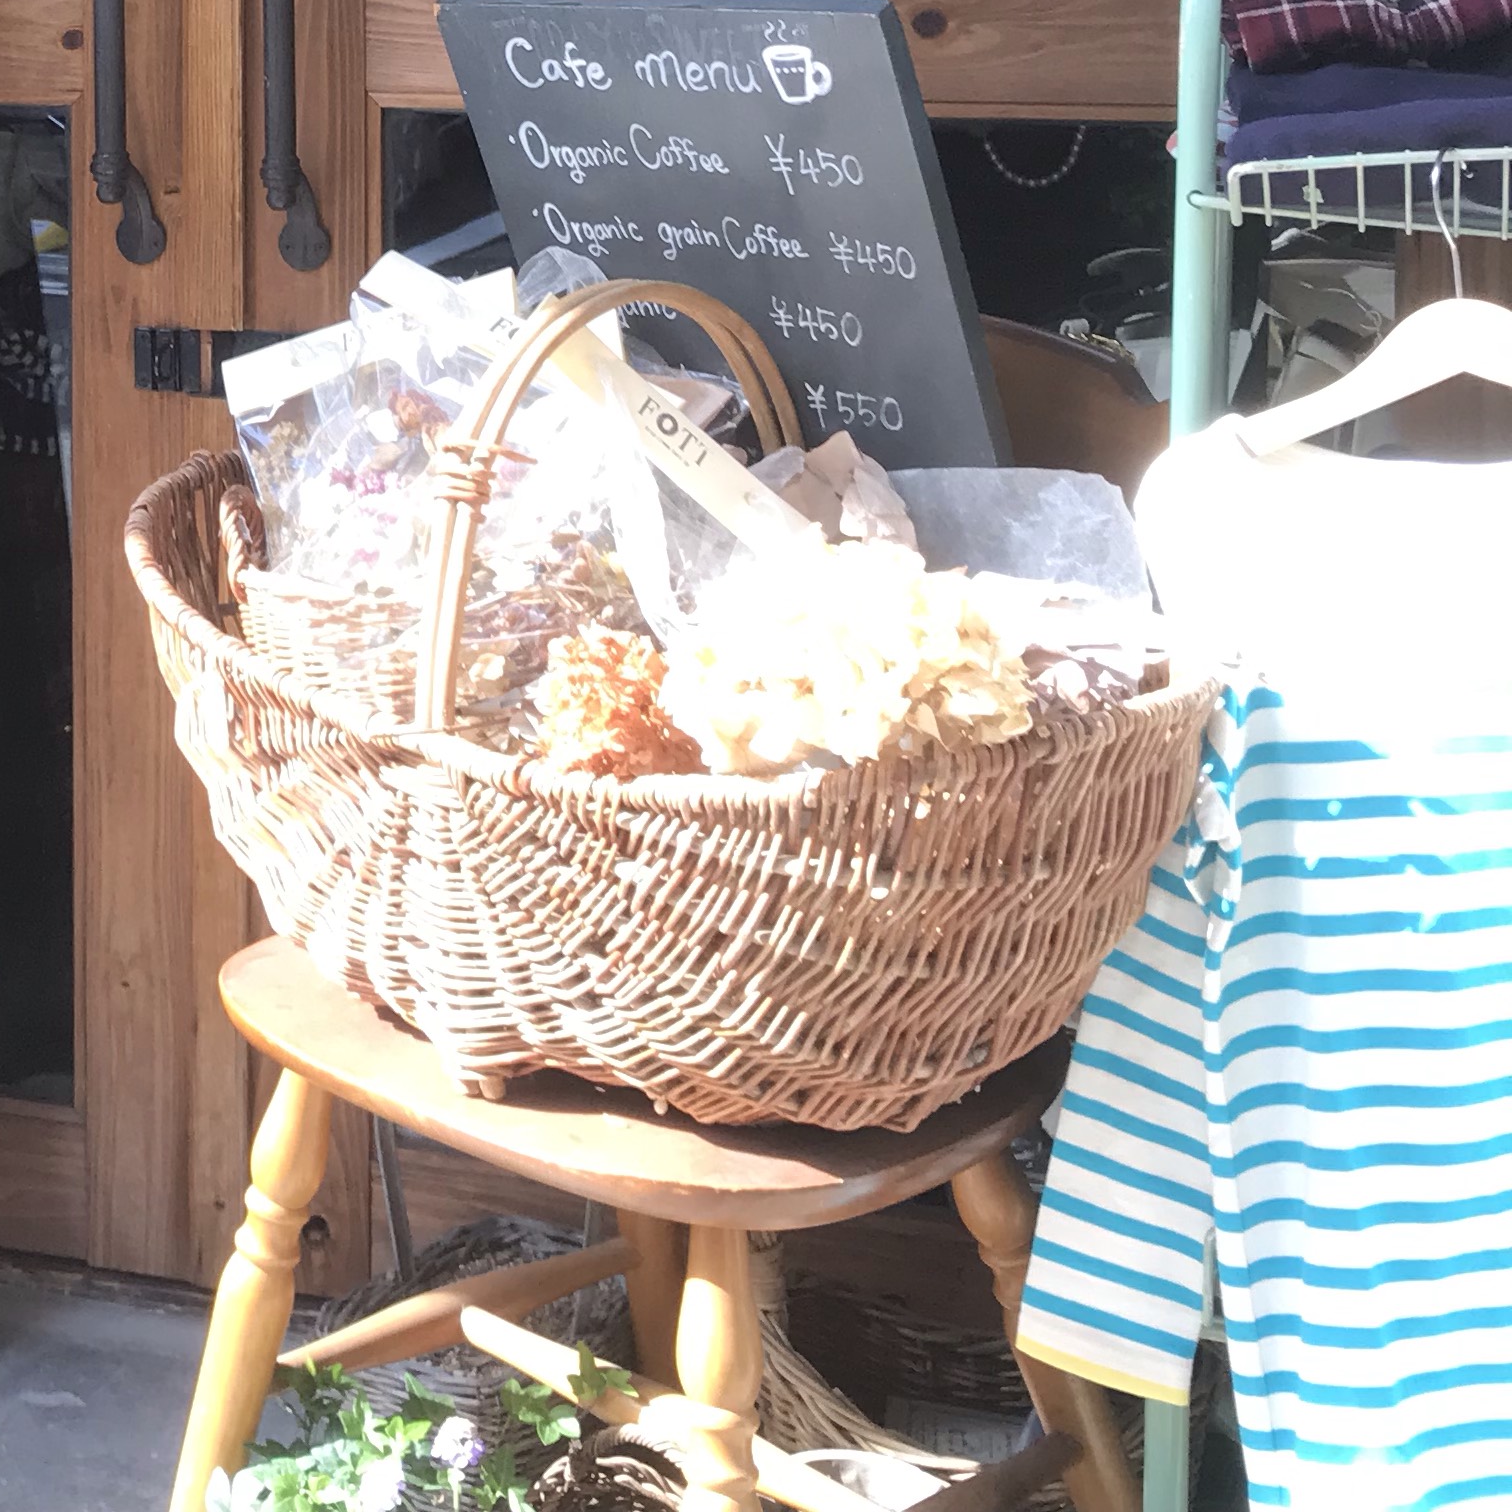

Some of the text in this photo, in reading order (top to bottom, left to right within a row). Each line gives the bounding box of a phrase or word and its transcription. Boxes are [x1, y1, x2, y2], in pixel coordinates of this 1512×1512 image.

[505, 37, 612, 90] Cafe
[629, 123, 730, 174] Coffee
[763, 133, 864, 194] ¥450
[657, 219, 721, 261] grain
[721, 216, 810, 260] Coffee
[828, 231, 916, 279] ¥450
[769, 295, 863, 347] ¥450
[804, 381, 903, 432] ¥550
